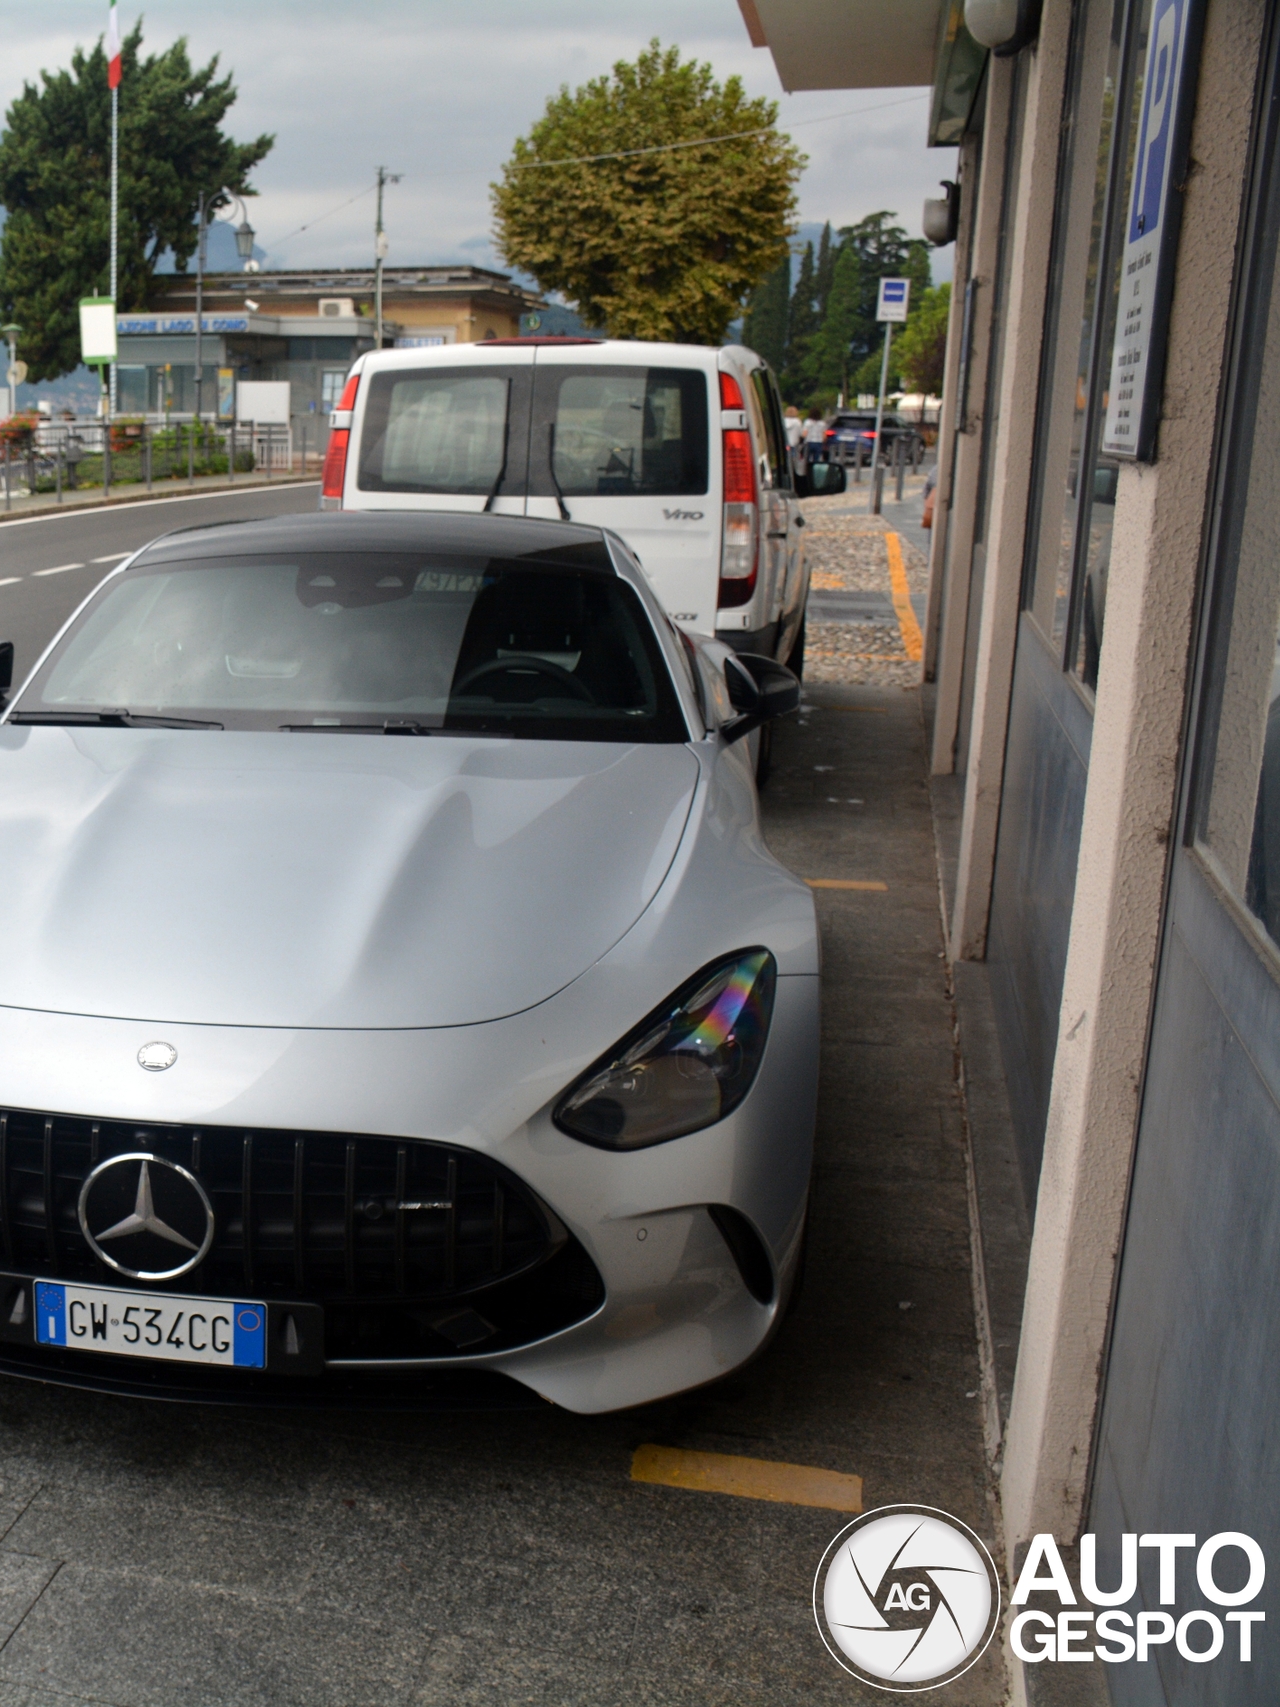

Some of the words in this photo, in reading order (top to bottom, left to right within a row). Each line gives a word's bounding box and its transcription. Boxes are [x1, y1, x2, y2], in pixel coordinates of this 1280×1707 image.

[1137, 3, 1176, 217] P
[116, 320, 157, 332] AZIONE
[162, 320, 194, 331] LAGO
[212, 318, 248, 331] COMO
[69, 1300, 108, 1341] GW
[122, 1306, 230, 1353] 534CG
